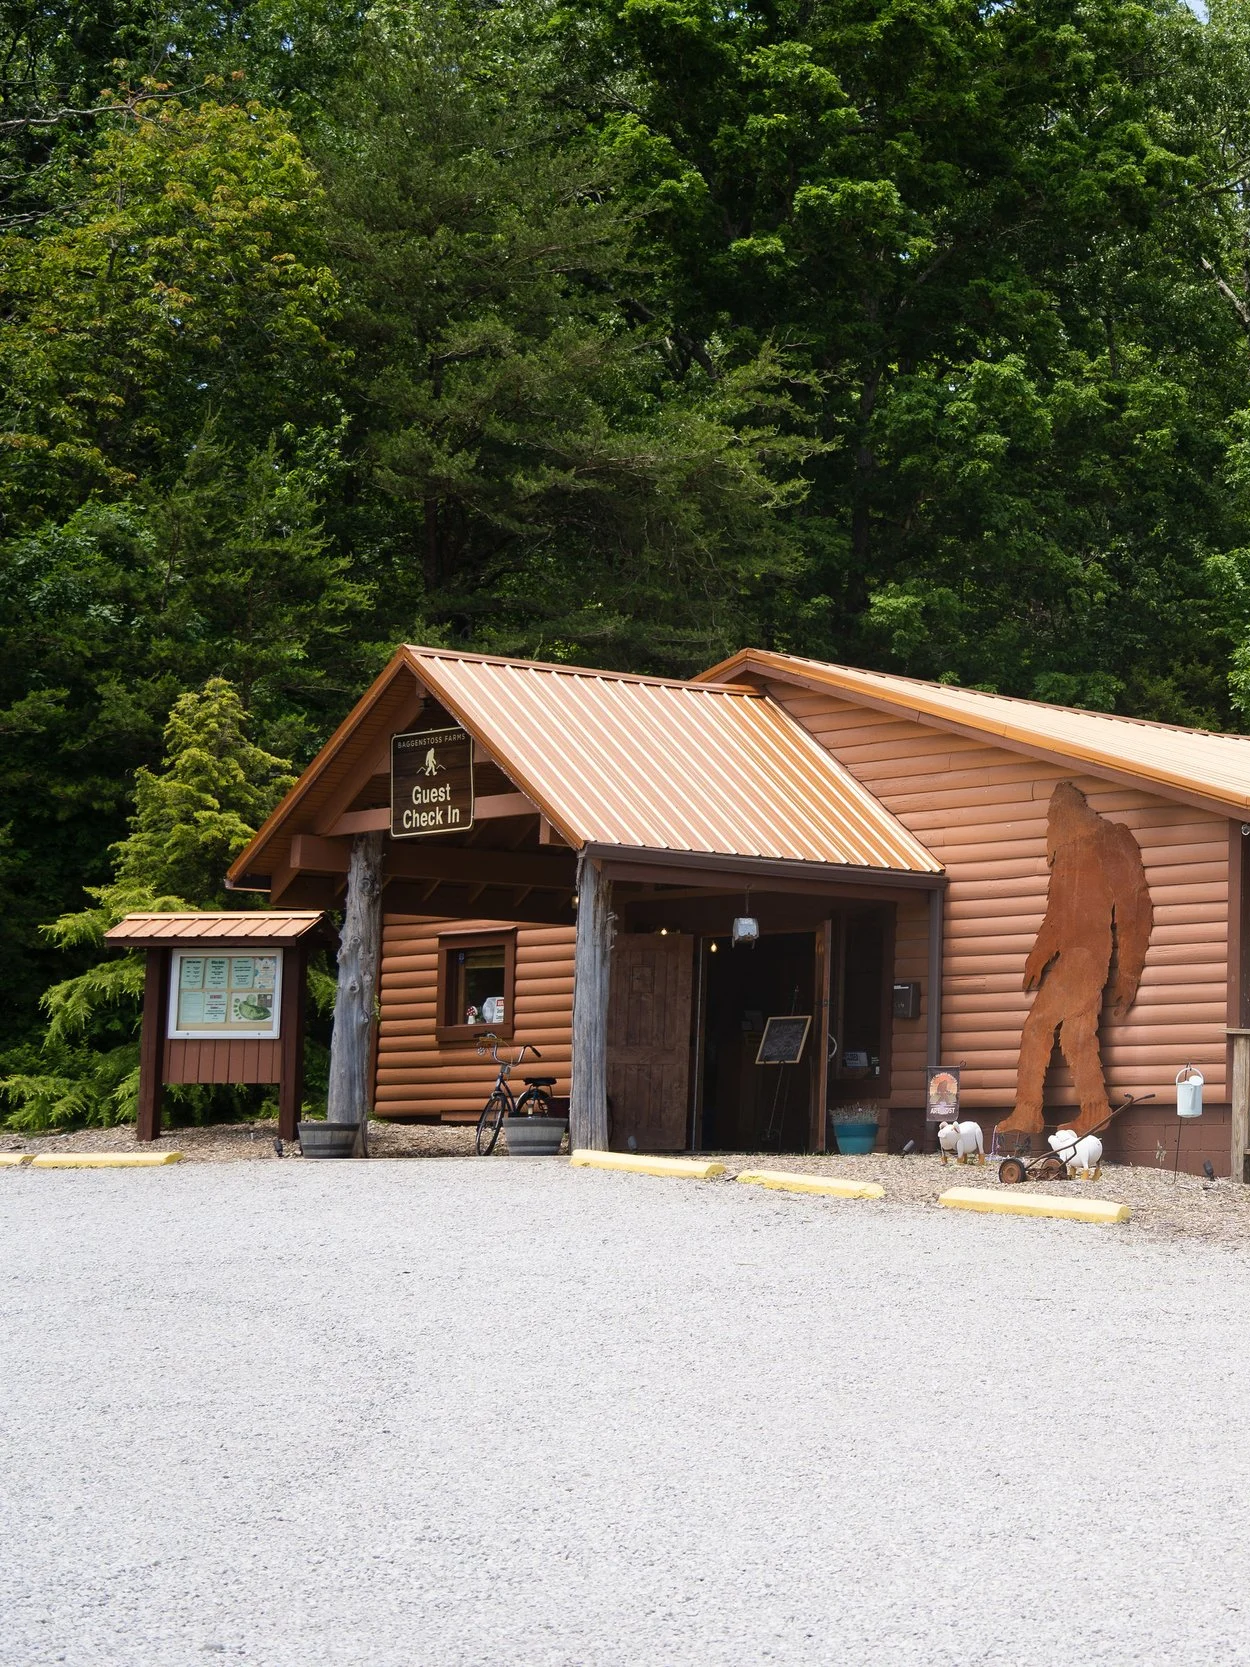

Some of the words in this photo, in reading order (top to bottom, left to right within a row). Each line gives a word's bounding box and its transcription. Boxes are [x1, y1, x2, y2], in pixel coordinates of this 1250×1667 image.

[398, 736, 442, 748] BAGGENSTOSS
[444, 733, 466, 742] FARMS
[412, 783, 451, 805] Guest
[403, 806, 443, 829] Check
[448, 805, 460, 824] In
